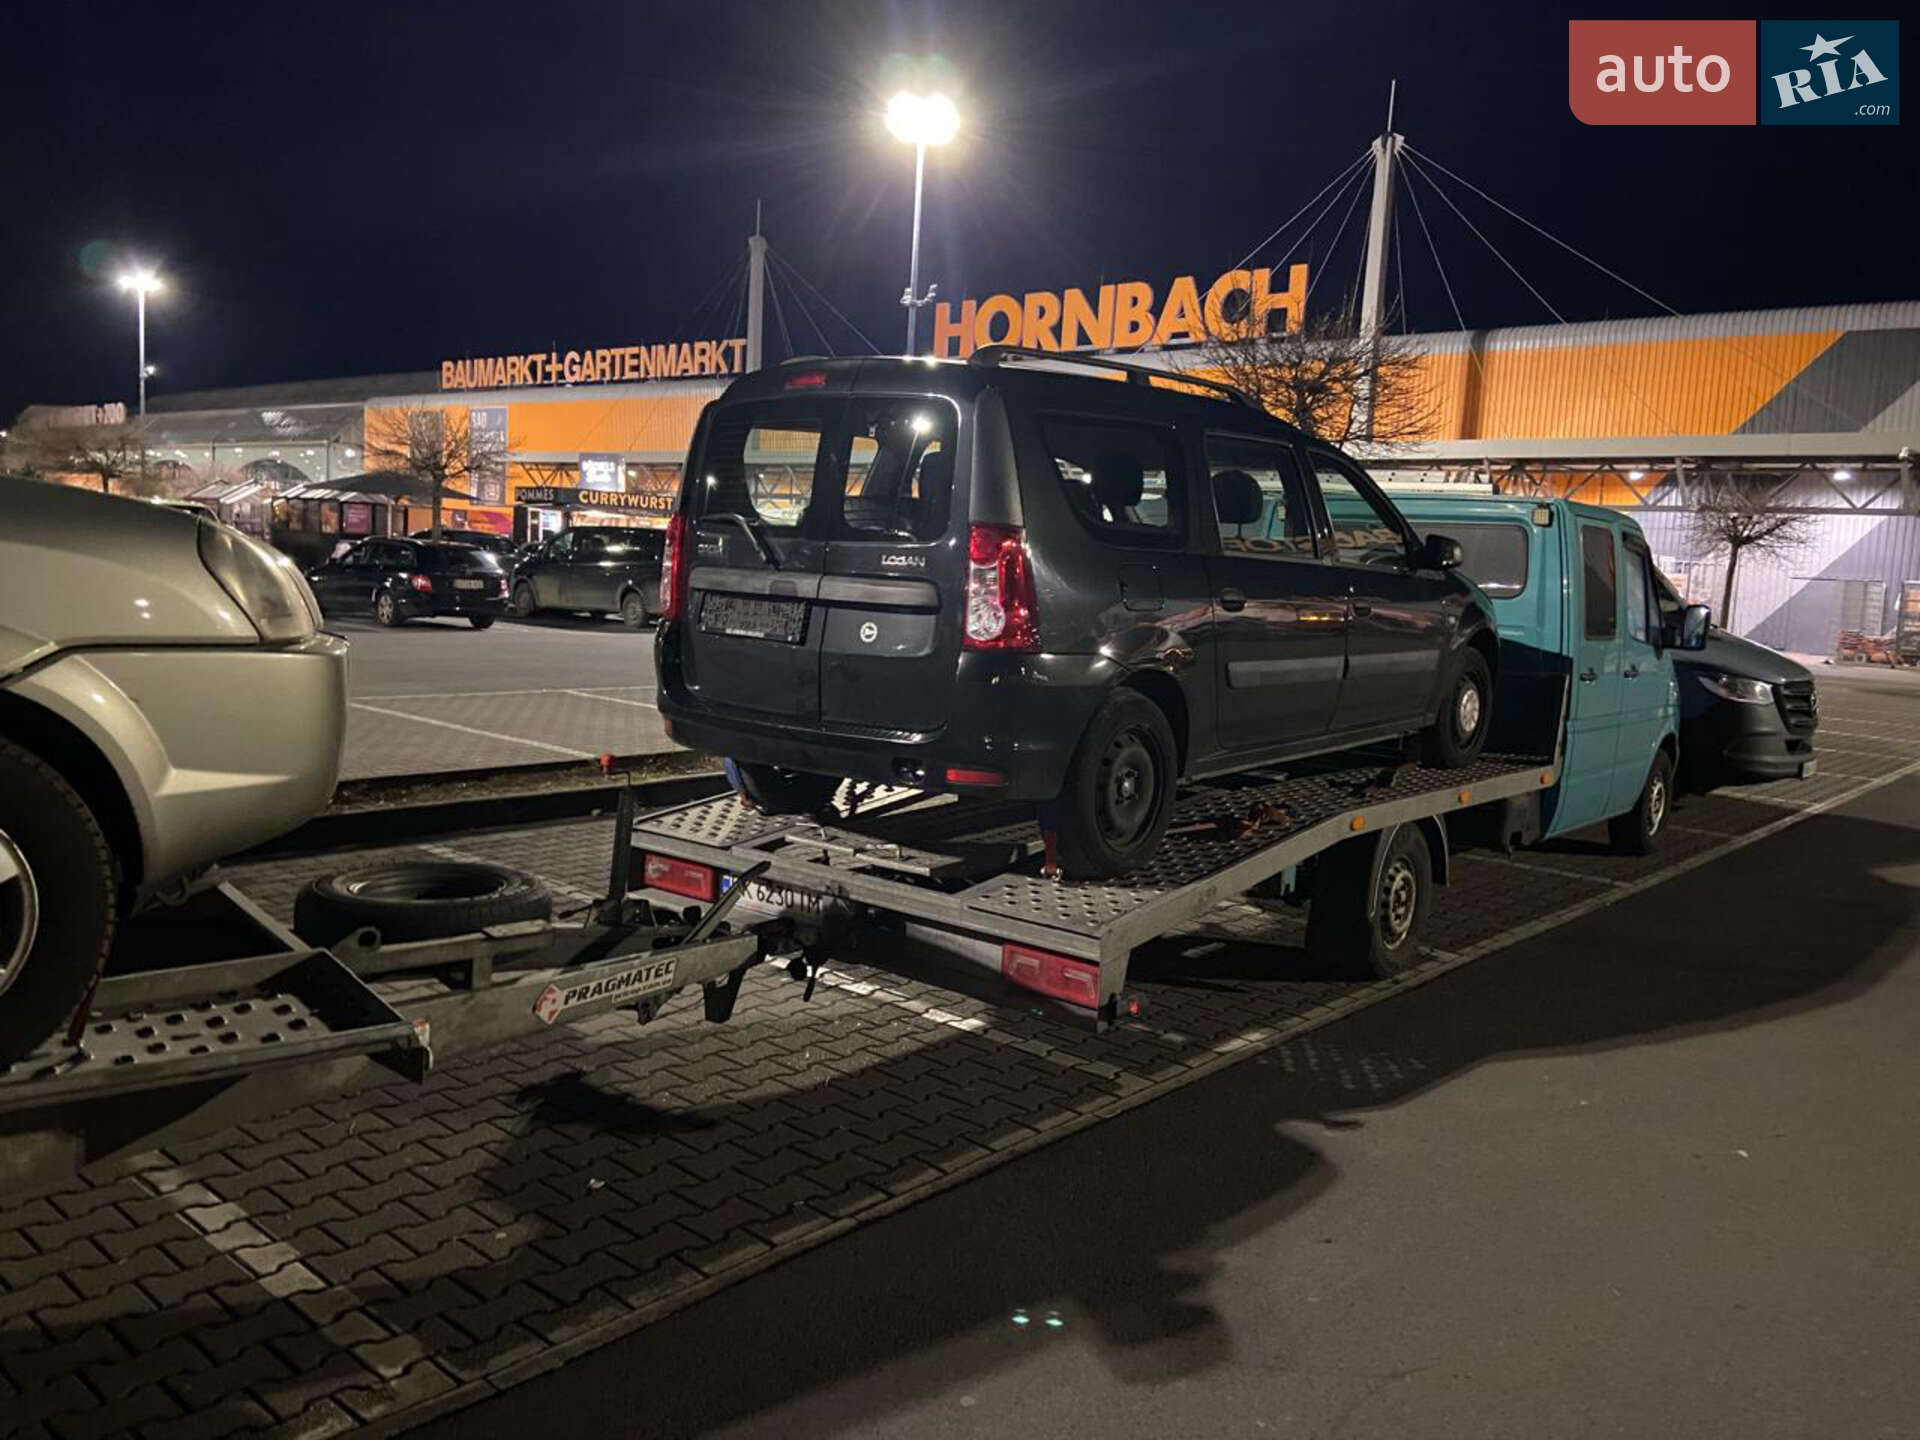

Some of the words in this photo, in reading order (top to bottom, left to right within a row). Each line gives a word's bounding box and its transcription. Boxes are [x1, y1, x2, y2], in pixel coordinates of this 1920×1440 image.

[934, 263, 1309, 360] HORNBACH
[578, 490, 673, 510] CURRYWURST
[756, 884, 794, 908] 6230
[563, 958, 676, 1006] PRAGMATEC
